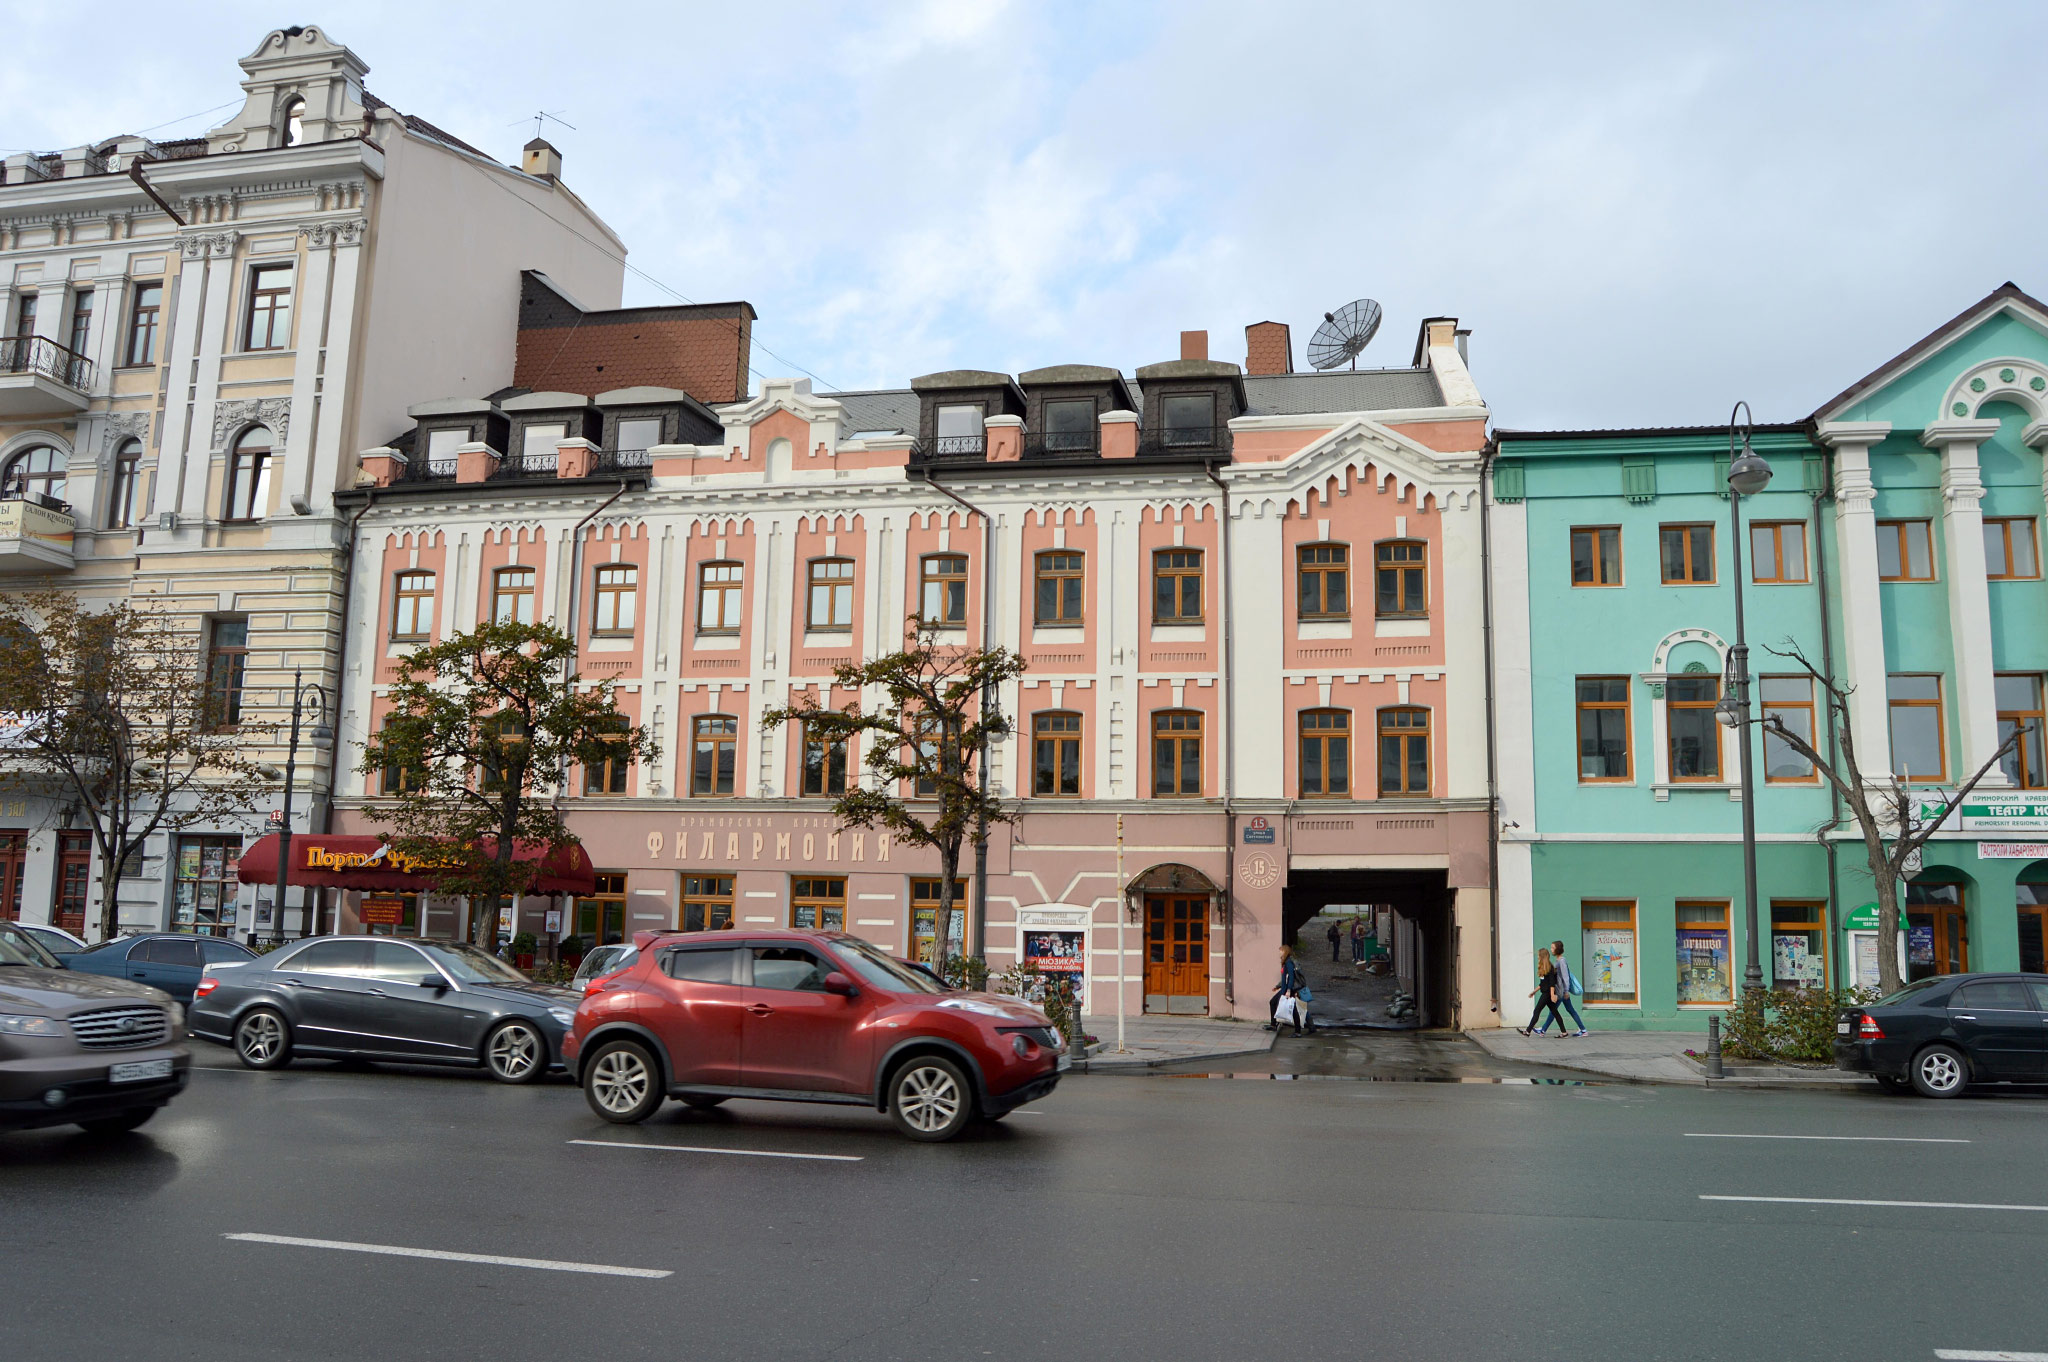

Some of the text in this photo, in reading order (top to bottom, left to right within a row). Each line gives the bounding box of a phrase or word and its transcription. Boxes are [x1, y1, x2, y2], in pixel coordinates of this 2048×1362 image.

[24, 505, 75, 527] САЛОН КРАСОТЫ
[8, 802, 25, 817] ЗАЛ
[272, 812, 282, 820] 13
[1988, 806, 2027, 816] ТЕАТР
[681, 817, 851, 828] ПРИМОРСКАЯ КРАЕВ
[1253, 818, 1265, 828] 15
[647, 832, 890, 861] ФИЛАРМОНИЯ
[1980, 843, 2007, 857] ГАСТРОЛИ
[307, 847, 381, 871] Порто
[1254, 860, 1265, 875] 15
